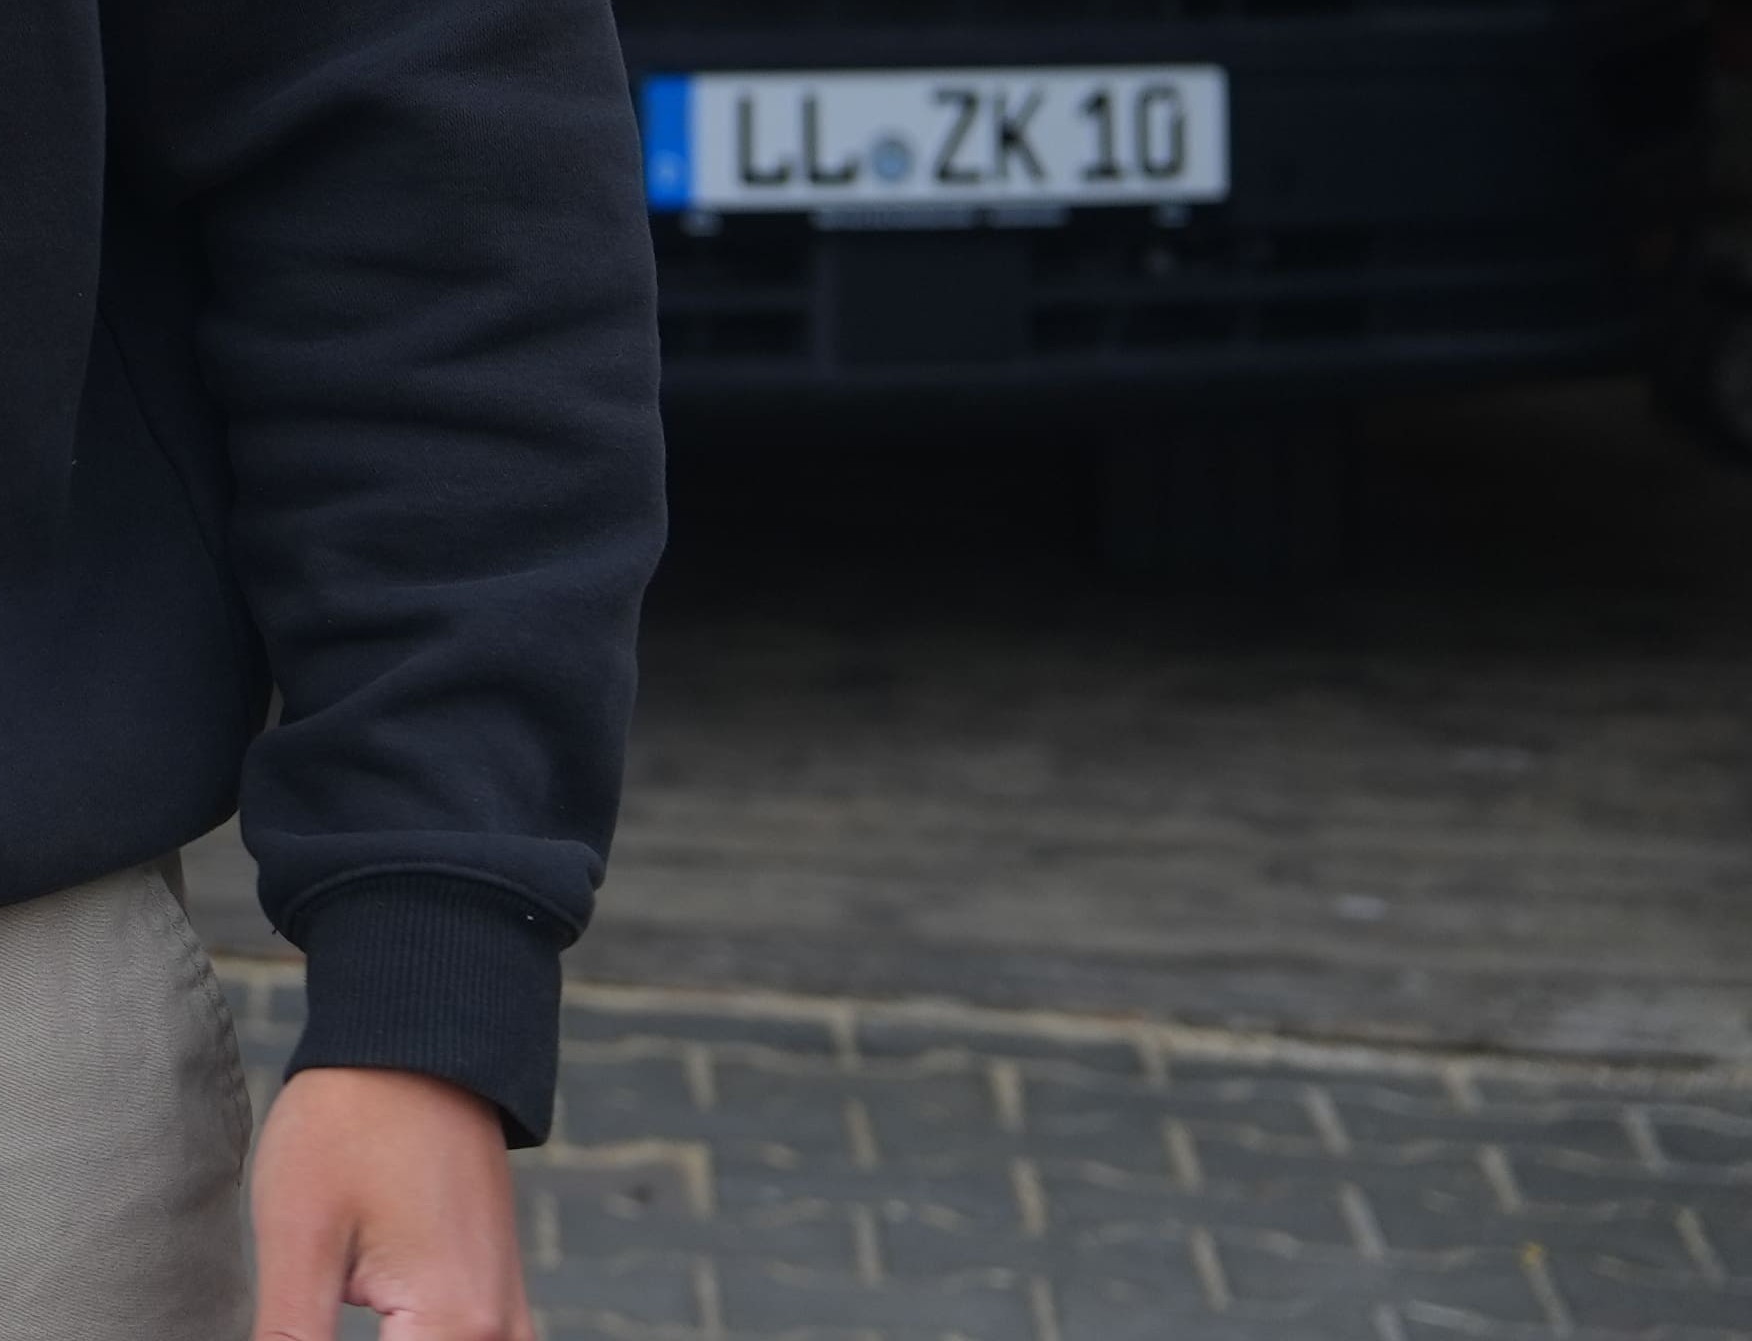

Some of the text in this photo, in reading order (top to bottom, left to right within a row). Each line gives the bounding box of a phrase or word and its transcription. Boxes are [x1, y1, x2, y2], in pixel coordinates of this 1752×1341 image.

[736, 91, 858, 187] LL
[930, 86, 1048, 185] ZK
[1081, 84, 1189, 181] 10
